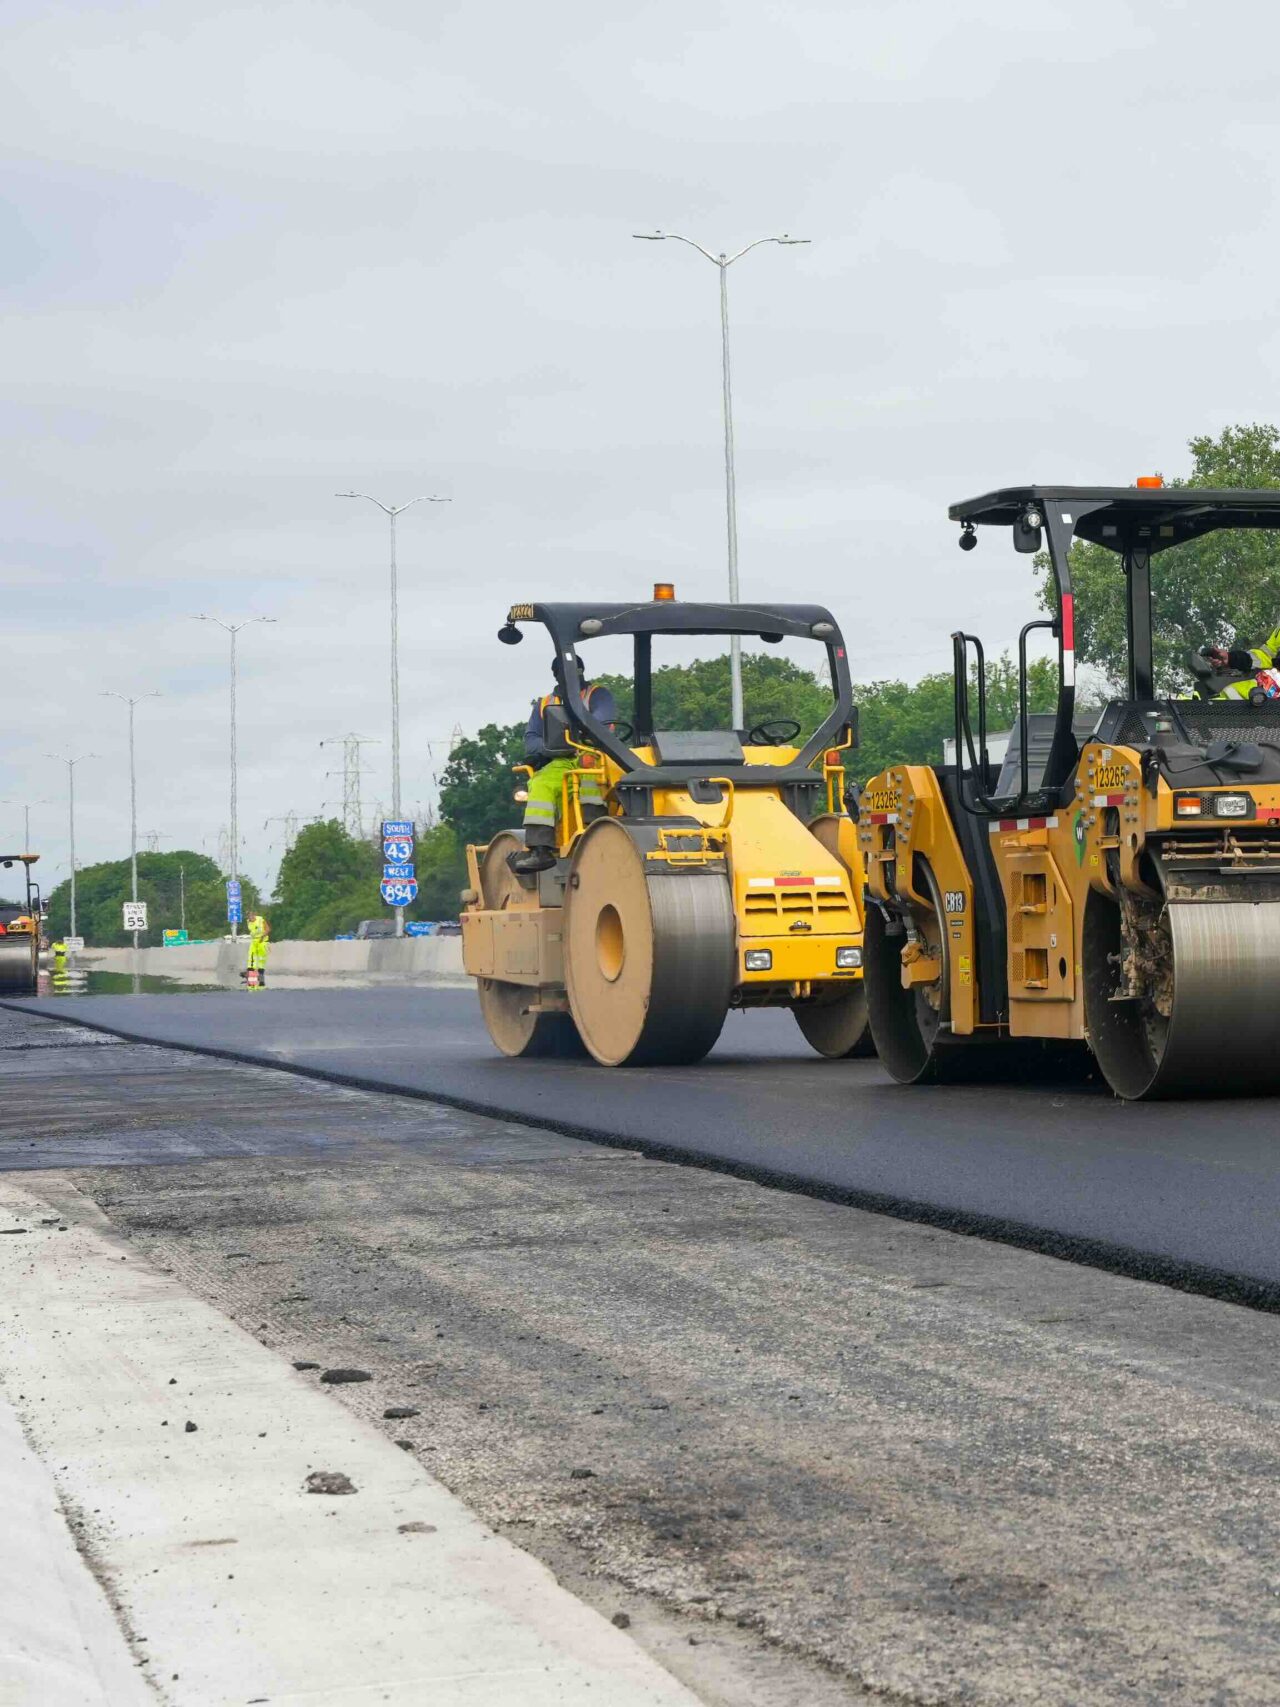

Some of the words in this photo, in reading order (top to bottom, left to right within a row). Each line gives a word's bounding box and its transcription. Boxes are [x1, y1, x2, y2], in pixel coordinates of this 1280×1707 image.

[1095, 766, 1125, 788] 123265
[872, 791, 898, 809] 123265
[386, 824, 410, 833] SOUTH
[387, 843, 410, 858] 43
[388, 867, 409, 876] WEST
[385, 885, 411, 901] 894
[945, 892, 963, 912] CB13
[127, 916, 145, 927] 55
